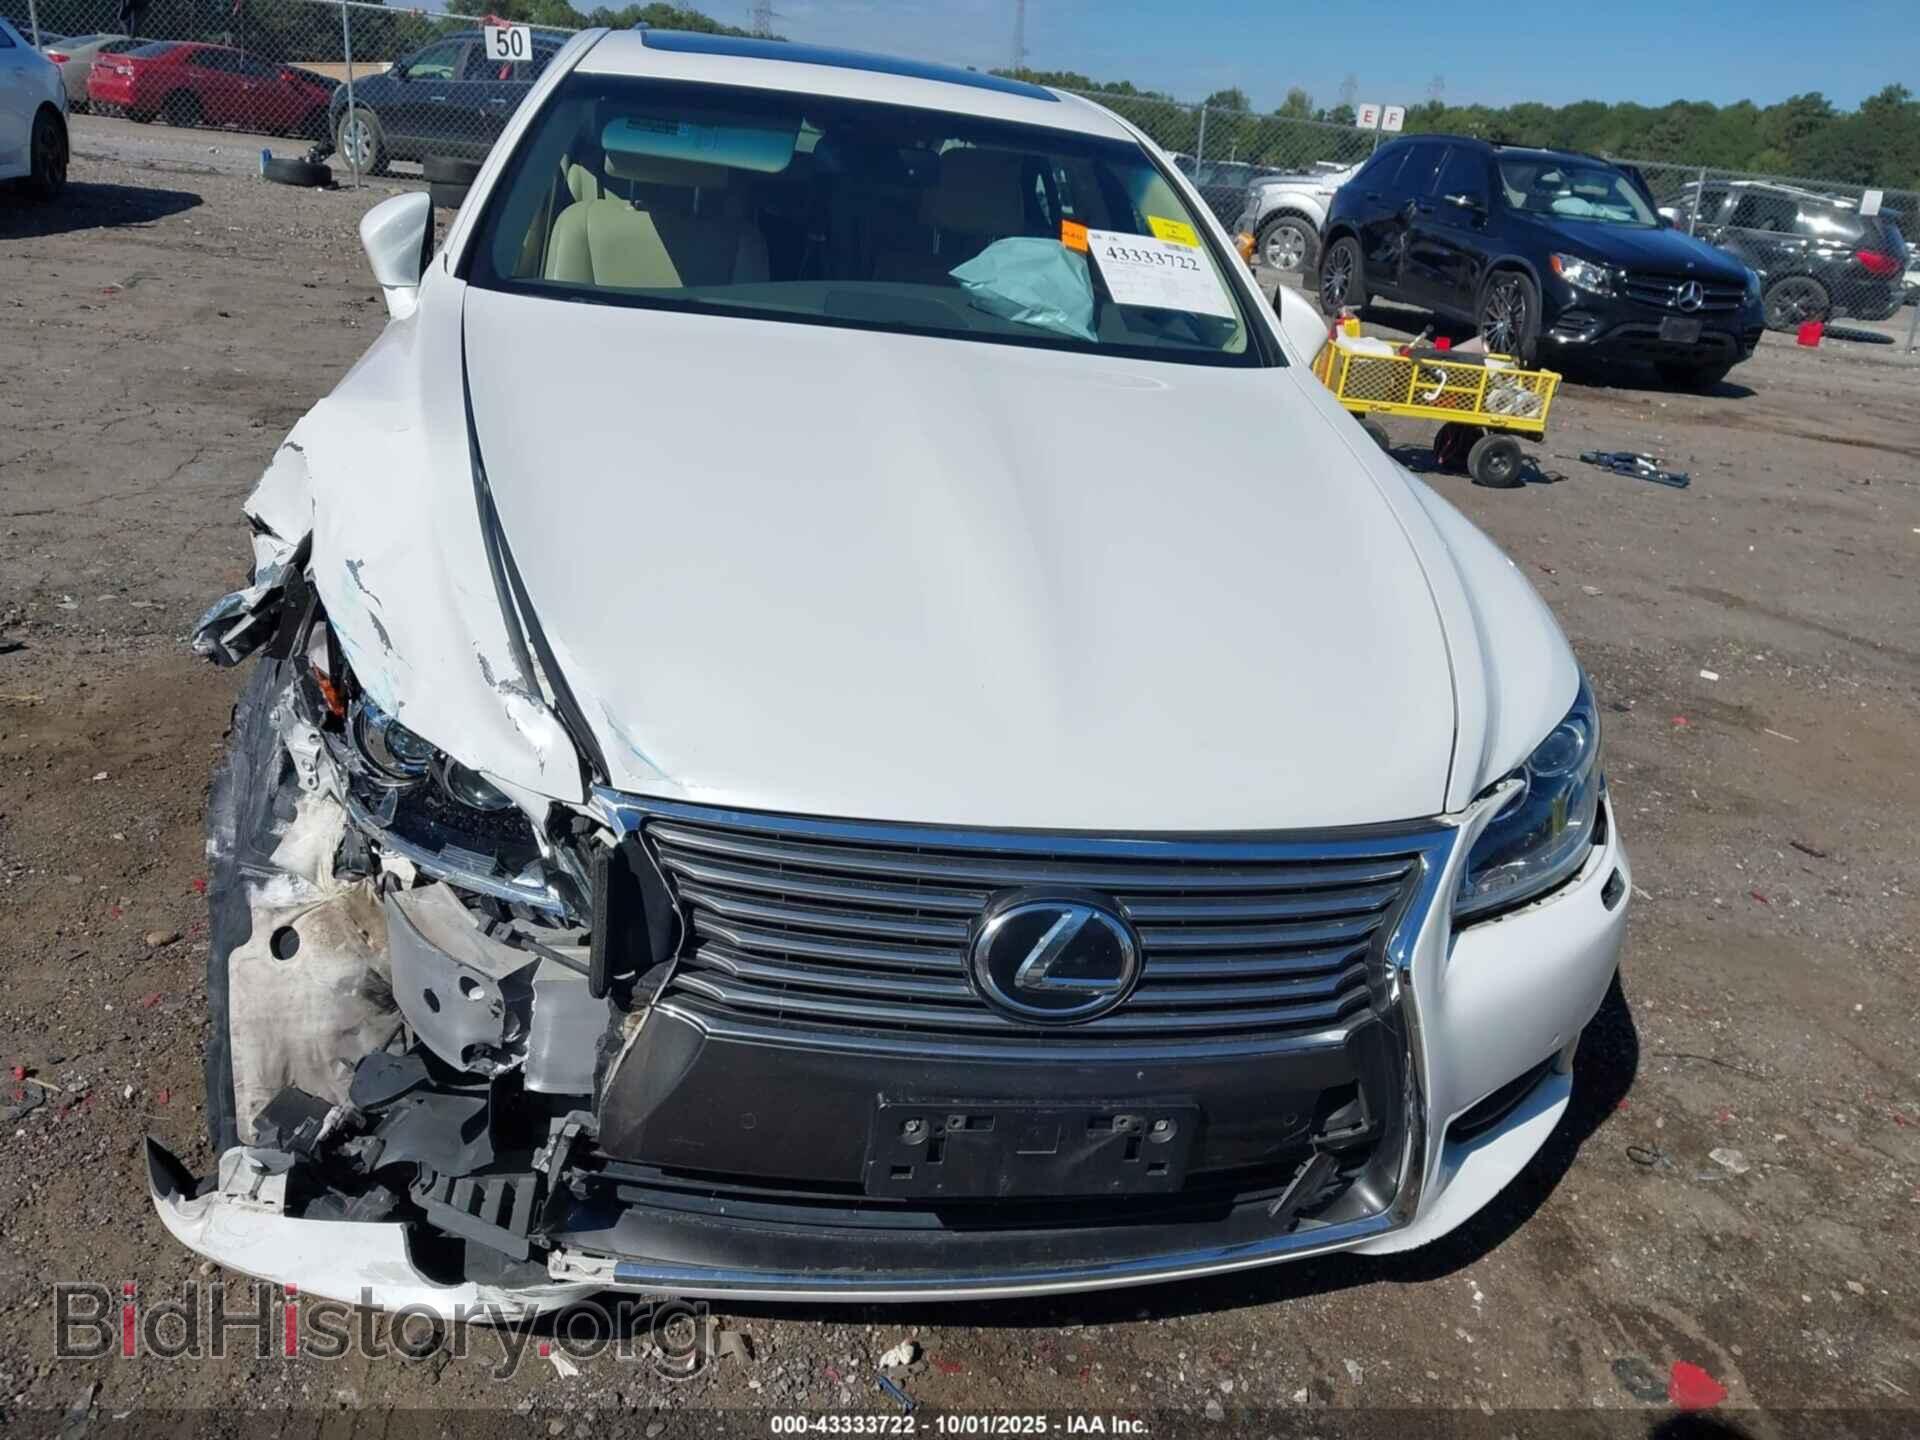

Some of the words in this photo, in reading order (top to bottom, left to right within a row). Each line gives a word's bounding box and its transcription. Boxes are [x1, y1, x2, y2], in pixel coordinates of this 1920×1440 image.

[496, 29, 523, 57] 50
[1363, 110, 1374, 123] E
[1388, 112, 1398, 125] F
[1106, 246, 1201, 272] 43333722
